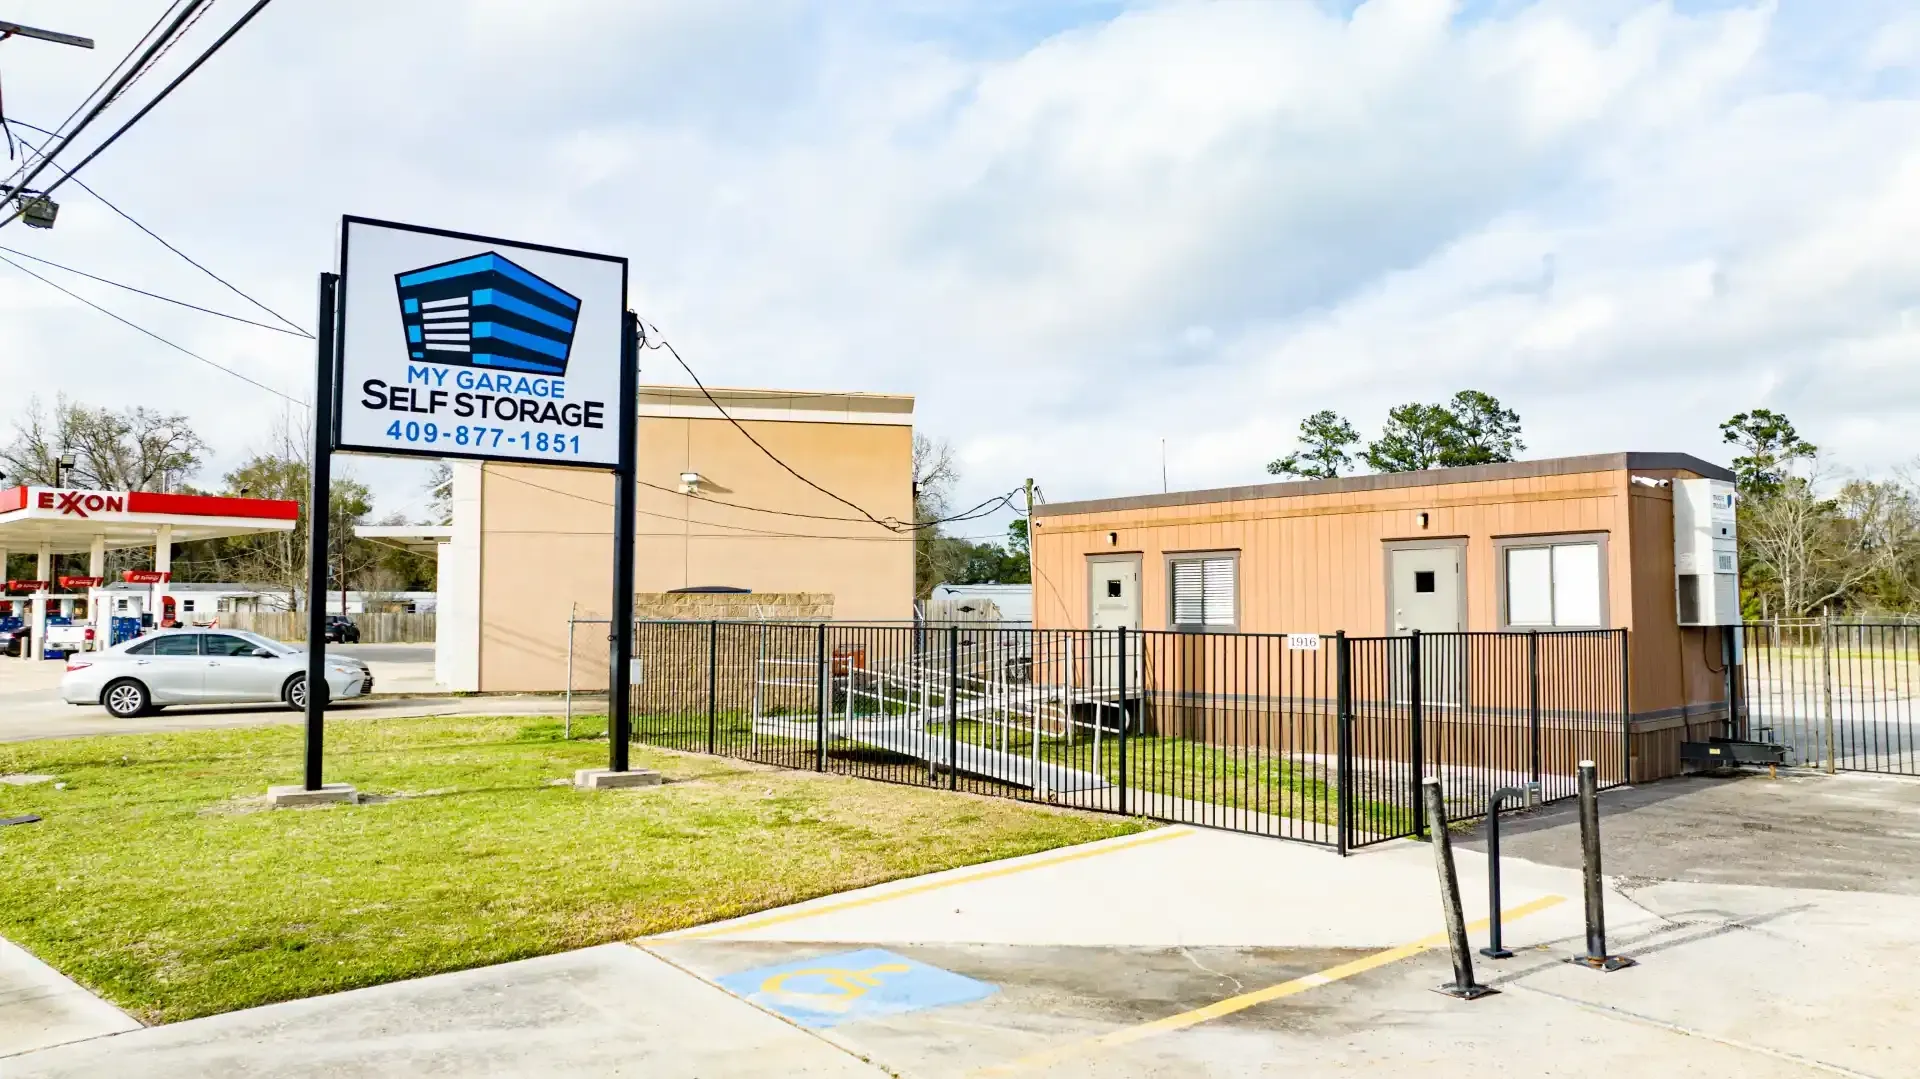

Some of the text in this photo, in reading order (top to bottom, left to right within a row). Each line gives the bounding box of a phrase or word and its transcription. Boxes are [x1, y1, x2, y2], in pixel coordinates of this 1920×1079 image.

[407, 366, 565, 399] MY GARAGE
[361, 379, 605, 429] SELF STORAGE
[386, 420, 579, 454] 409-877-1851
[38, 491, 123, 517] EXXON
[1291, 637, 1317, 647] 1916
